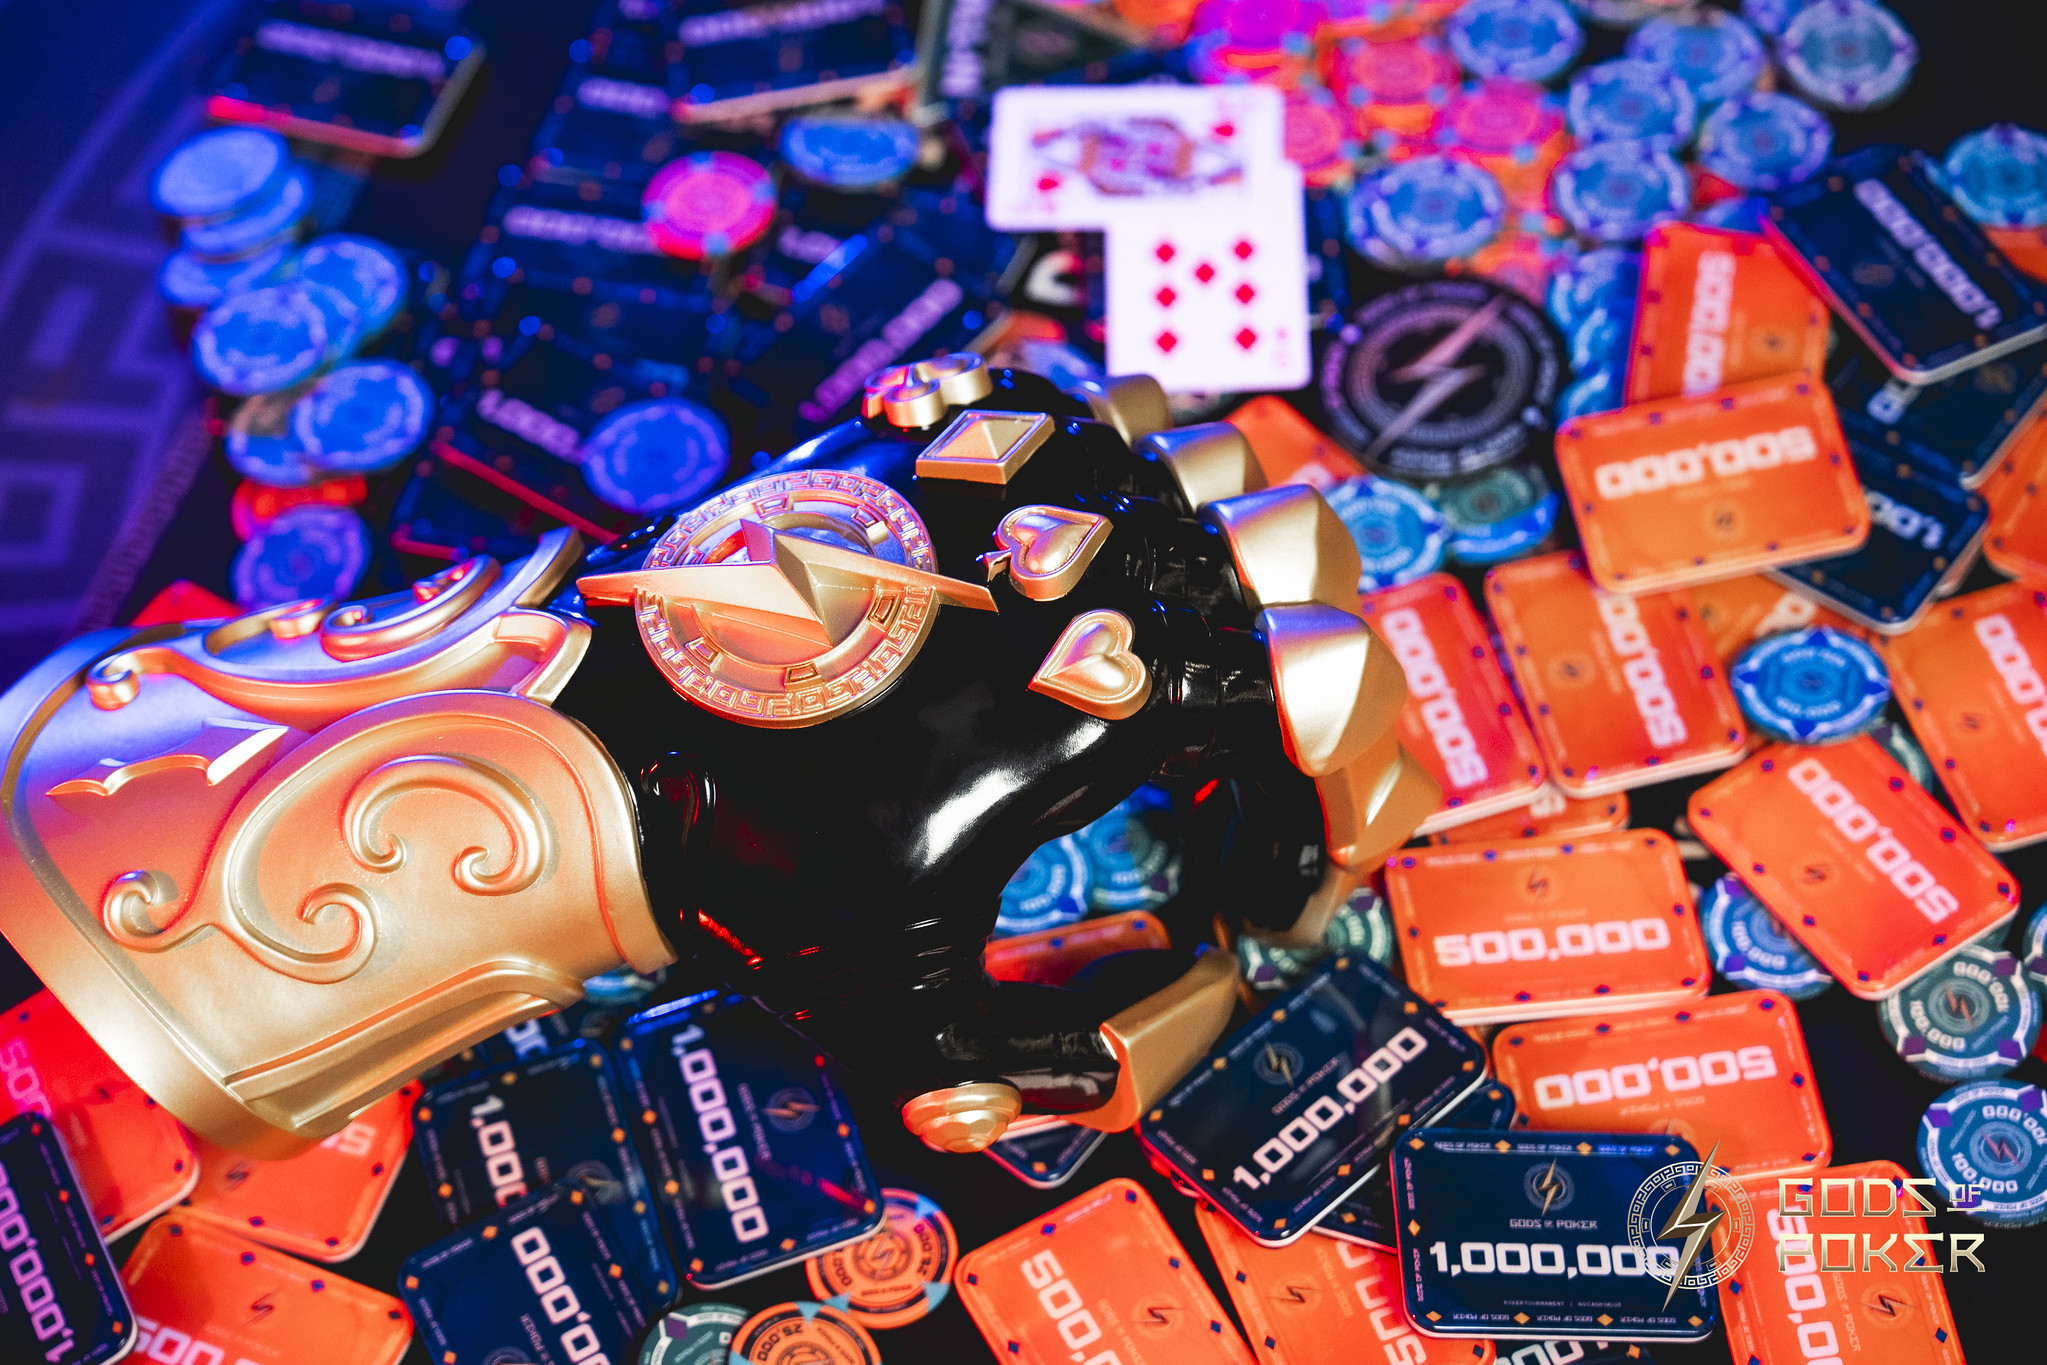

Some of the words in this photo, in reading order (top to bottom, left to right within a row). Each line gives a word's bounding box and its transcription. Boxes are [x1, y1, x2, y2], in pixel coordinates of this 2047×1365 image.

[1596, 425, 1818, 500] 500,000
[1381, 607, 1490, 789] 500,000
[1787, 758, 1960, 924] 500,000
[1433, 917, 1671, 968] 500,000
[1953, 961, 2010, 1013] 100,000
[1909, 1000, 1966, 1053] 100,000
[1533, 1045, 1778, 1111] 500,000
[671, 1023, 770, 1244] 1,000,000
[1232, 1026, 1430, 1190] 1,000,000
[1952, 1151, 2018, 1194] 100,000
[1510, 1218, 1542, 1229] GODS
[1556, 1219, 1598, 1230] POKER
[1429, 1241, 1680, 1280] 1,000,000
[757, 1323, 804, 1362] 25,000
[1842, 1312, 1864, 1354] POKER
